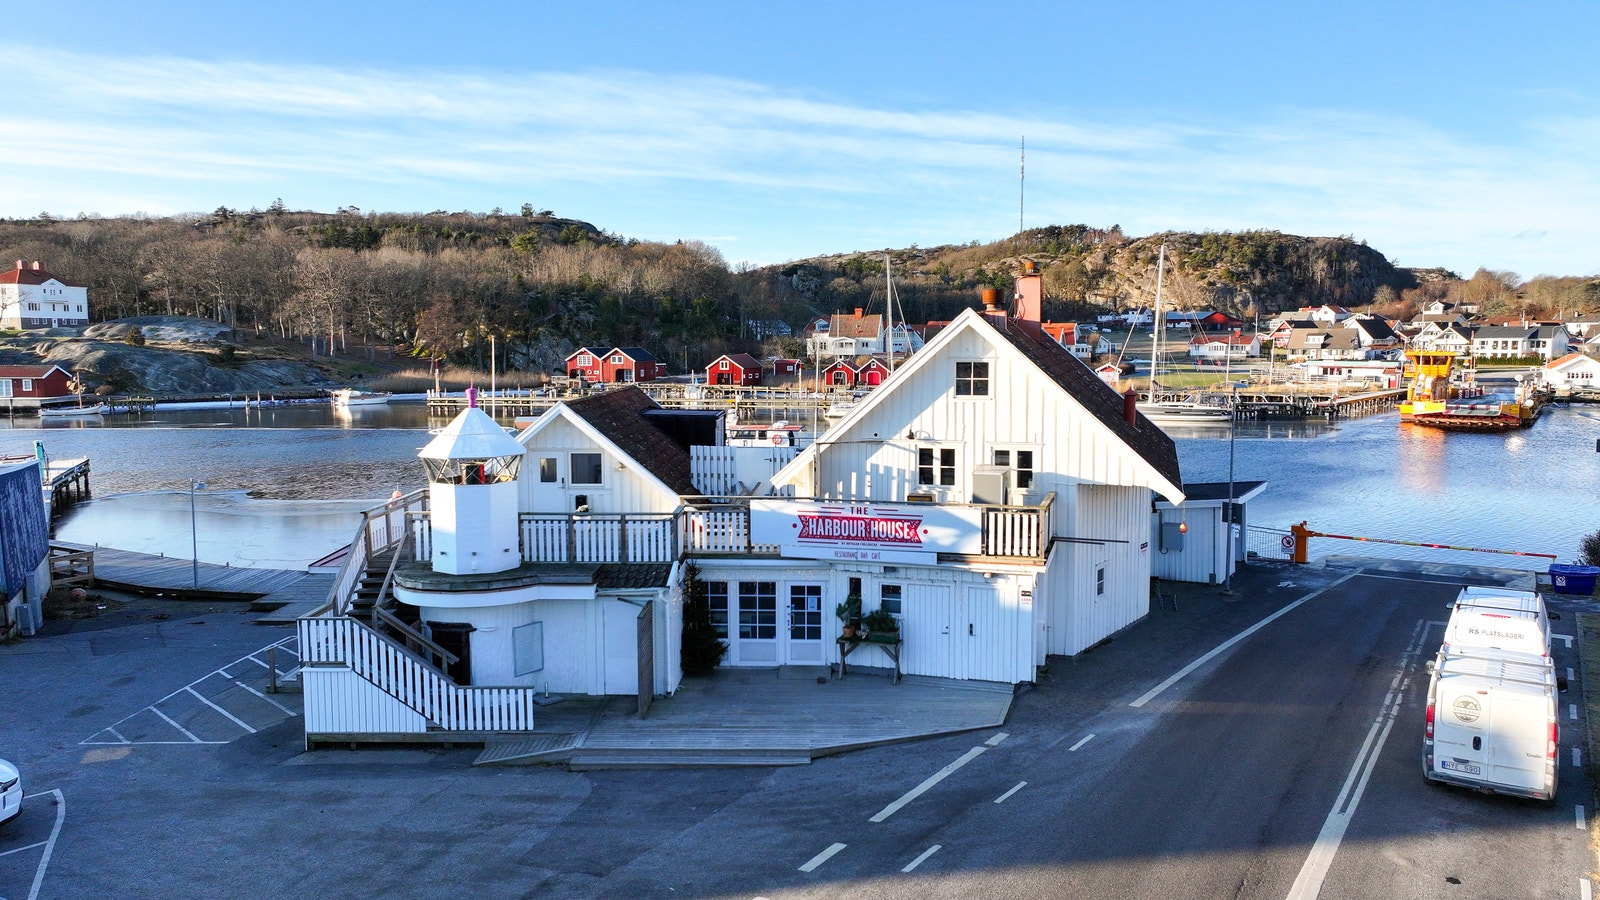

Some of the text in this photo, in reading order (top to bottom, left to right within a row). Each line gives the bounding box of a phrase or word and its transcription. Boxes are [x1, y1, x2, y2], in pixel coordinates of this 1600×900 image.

[851, 507, 868, 515] THE
[808, 517, 911, 539] HARBOUR HOUSE
[1481, 629, 1525, 639] PLATSLAGERI
